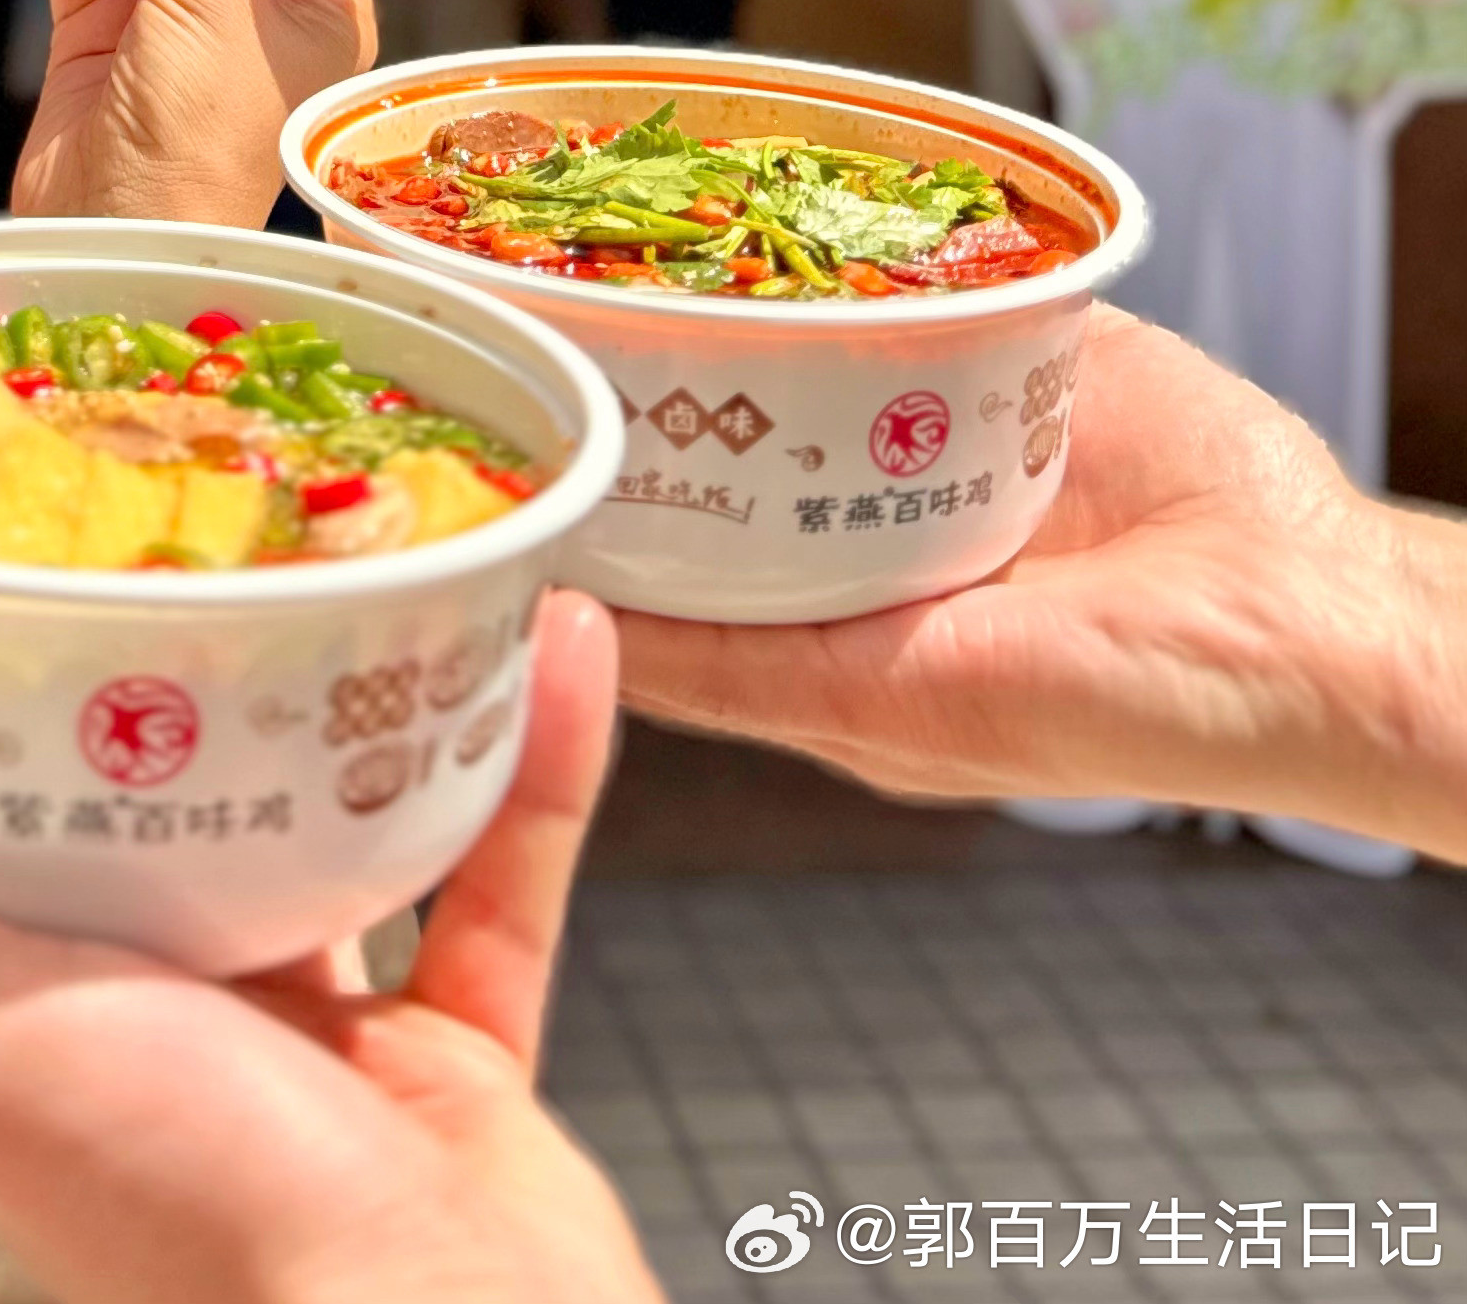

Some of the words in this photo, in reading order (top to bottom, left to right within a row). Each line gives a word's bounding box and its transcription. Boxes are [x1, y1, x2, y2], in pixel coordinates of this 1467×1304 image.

[794, 472, 994, 534] 紫燕百味鸡
